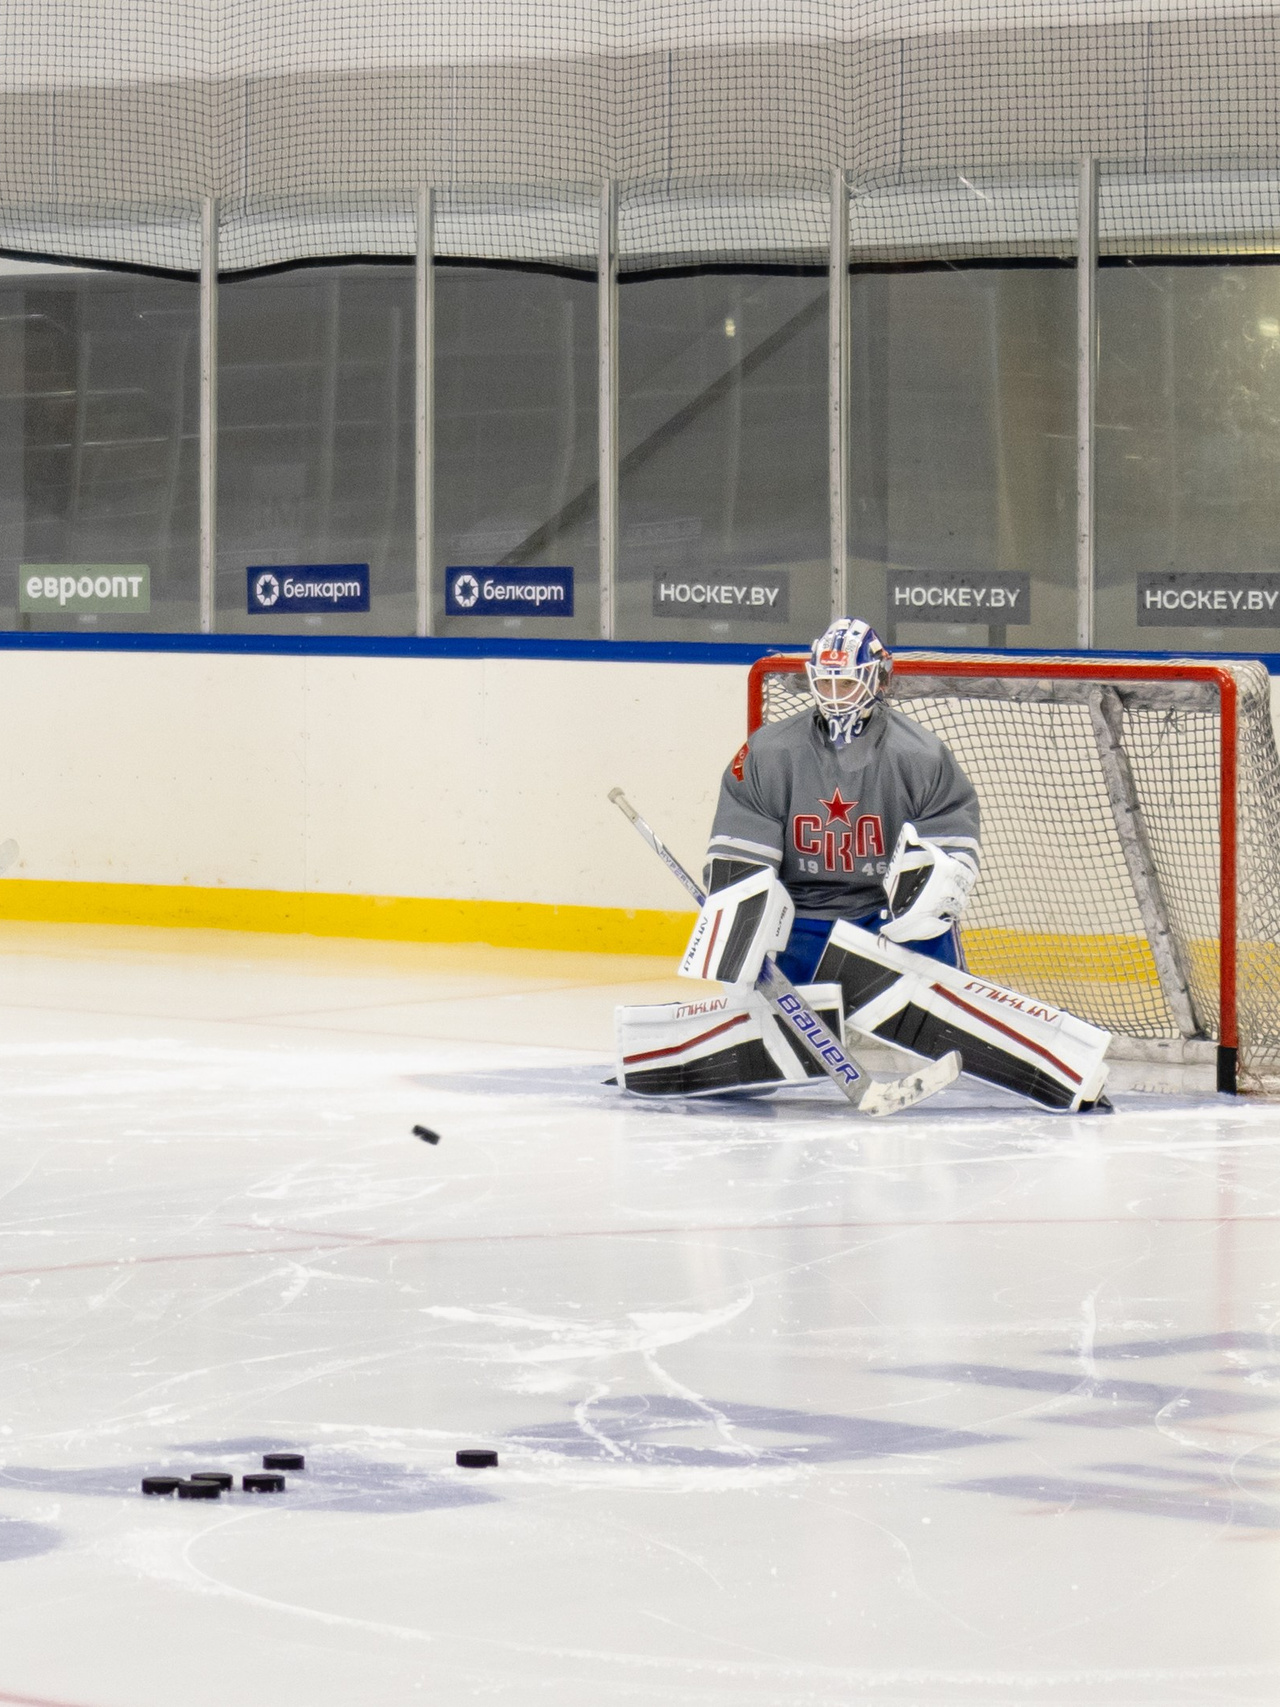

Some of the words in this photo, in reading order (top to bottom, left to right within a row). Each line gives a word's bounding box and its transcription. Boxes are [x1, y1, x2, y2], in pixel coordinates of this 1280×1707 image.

[26, 575, 143, 606] евроопт
[283, 578, 361, 602] белкарт
[483, 579, 564, 606] белкарт
[660, 583, 779, 606] HOCKEY.BY
[894, 587, 1020, 607] HOCKEY.BY
[1146, 590, 1279, 610] HOCKEY.BY
[798, 858, 819, 874] 19
[861, 861, 889, 876] 46
[676, 997, 728, 1019] MIKLIN
